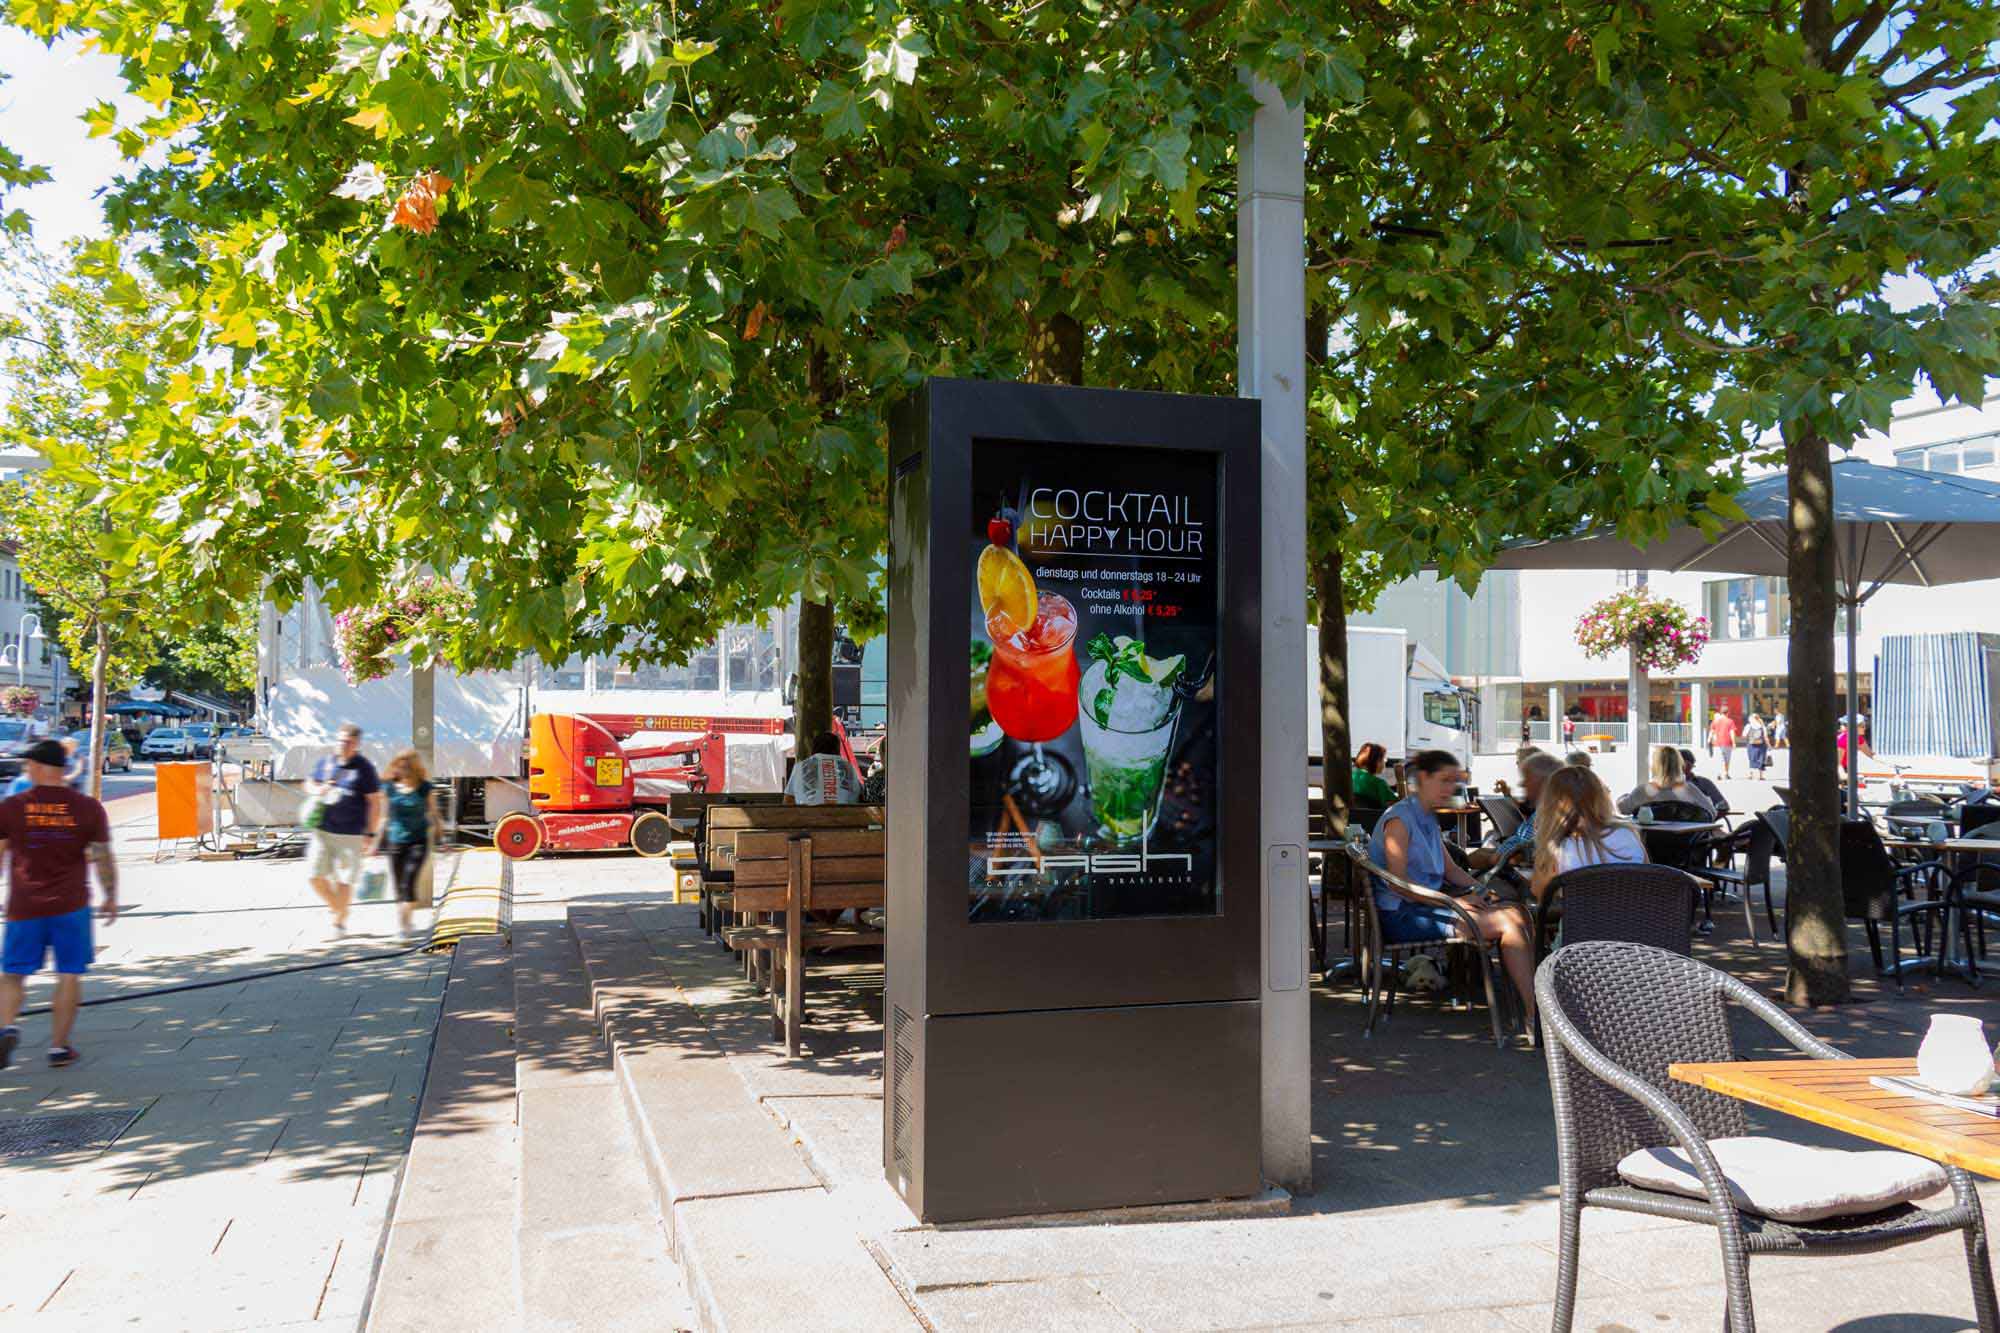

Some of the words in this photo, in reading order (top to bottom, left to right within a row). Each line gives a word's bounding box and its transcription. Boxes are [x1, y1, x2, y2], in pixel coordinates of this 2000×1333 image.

[1031, 488, 1203, 525] COCKTAIL
[1030, 523, 1121, 549] HAPPY
[1128, 527, 1203, 552] HOUR
[1036, 566, 1079, 581] dienstags
[1081, 568, 1098, 580] und
[1100, 569, 1153, 584] donnerstags
[1187, 572, 1202, 583] Uhr
[1081, 587, 1121, 600] Cocktails
[1089, 603, 1112, 615] ohne
[1113, 603, 1145, 616] Alkohol
